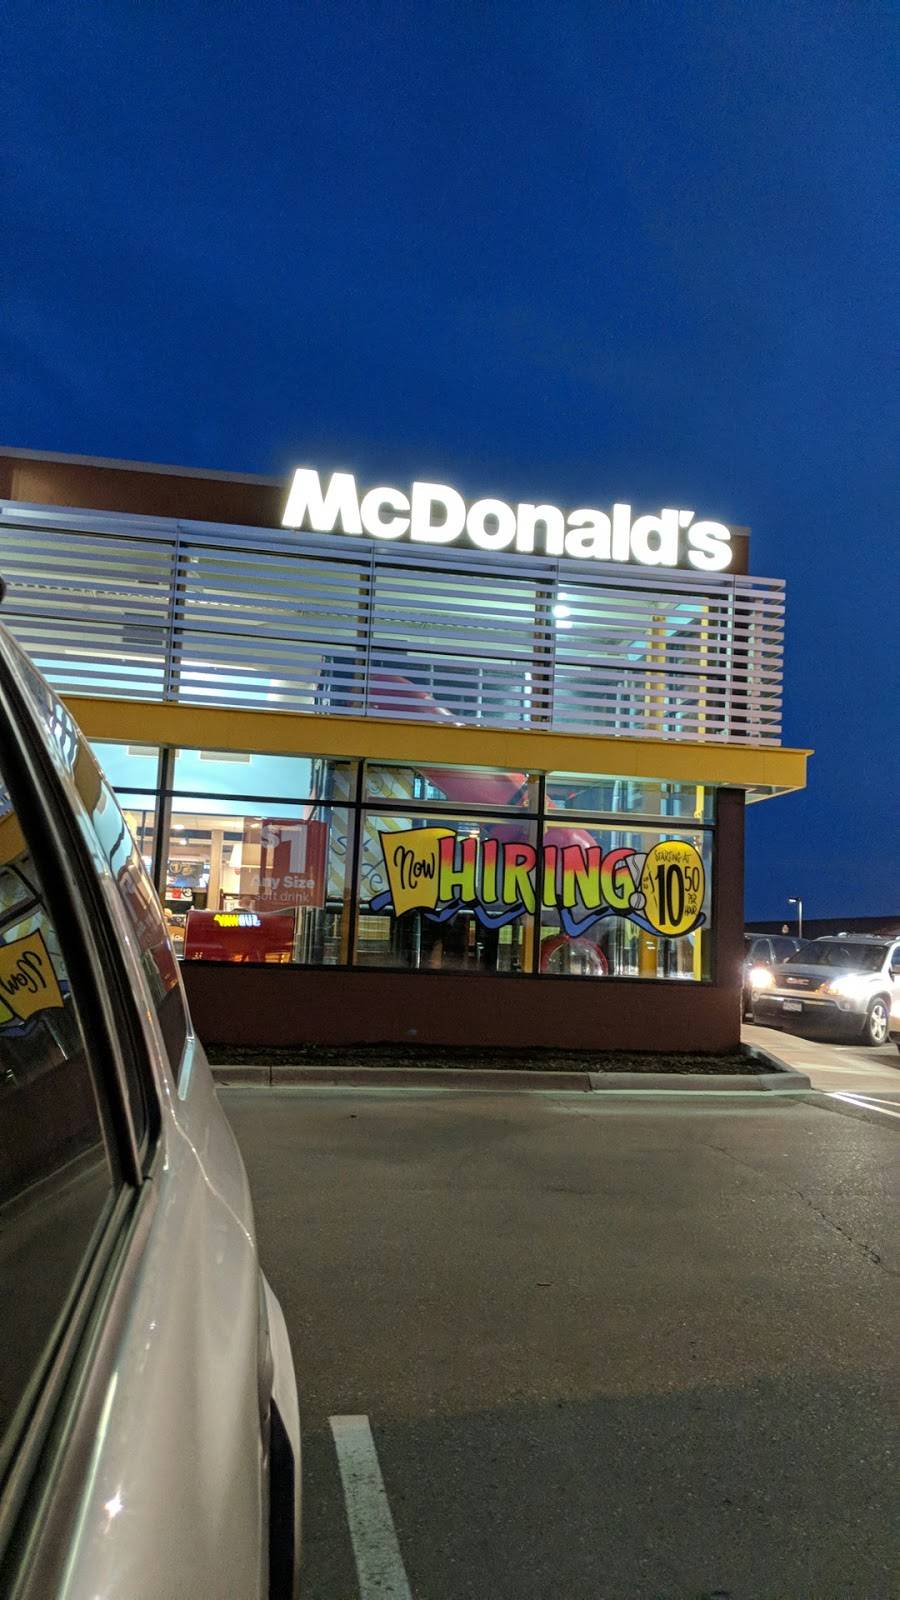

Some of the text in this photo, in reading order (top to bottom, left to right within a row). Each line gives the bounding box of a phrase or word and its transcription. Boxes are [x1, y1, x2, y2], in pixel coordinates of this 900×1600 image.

[282, 468, 733, 571] McDonald's
[395, 845, 435, 889] Now
[283, 876, 315, 888] Size
[256, 891, 309, 902] soft drink
